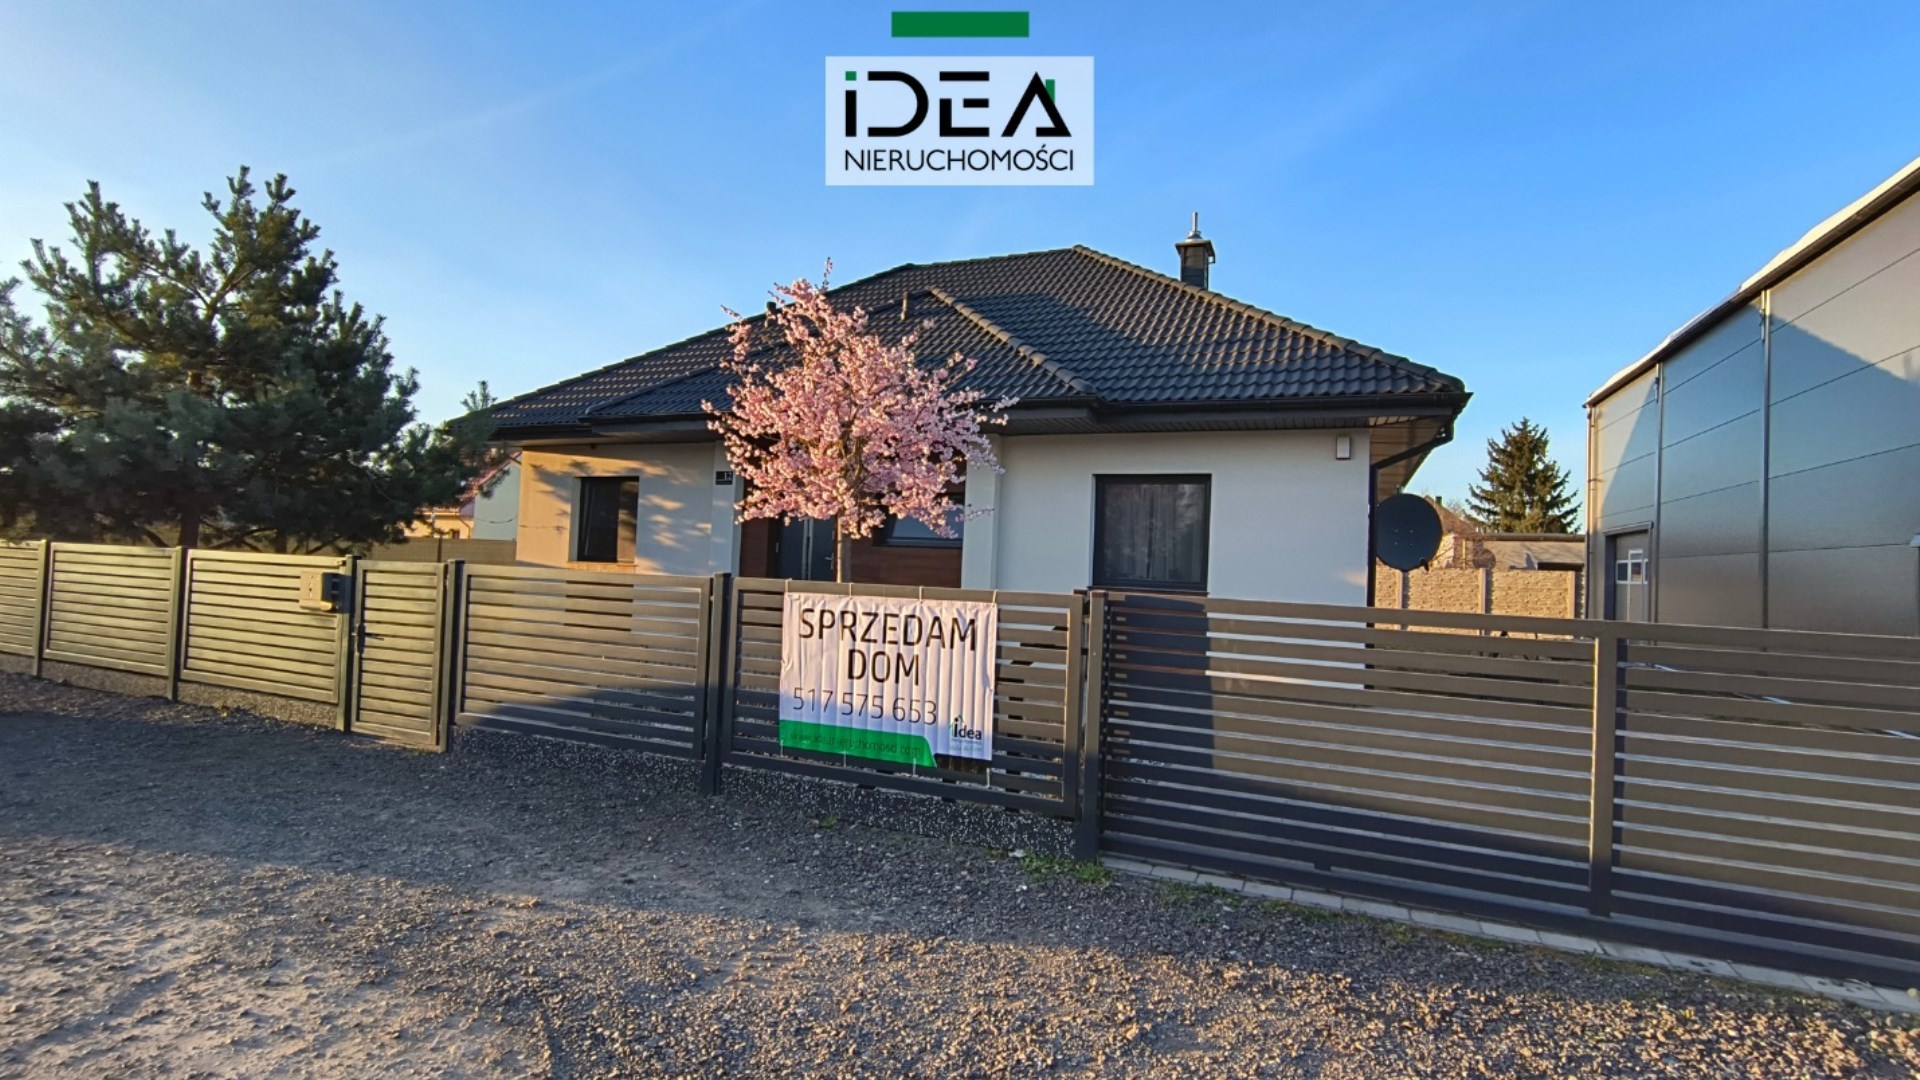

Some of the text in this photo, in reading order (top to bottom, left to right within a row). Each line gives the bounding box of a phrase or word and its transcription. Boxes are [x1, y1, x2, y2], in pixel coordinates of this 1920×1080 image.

[799, 607, 976, 651] SPRZEDAM
[847, 649, 919, 686] DOM
[792, 687, 937, 725] 517 575 653
[953, 717, 982, 741] idea
